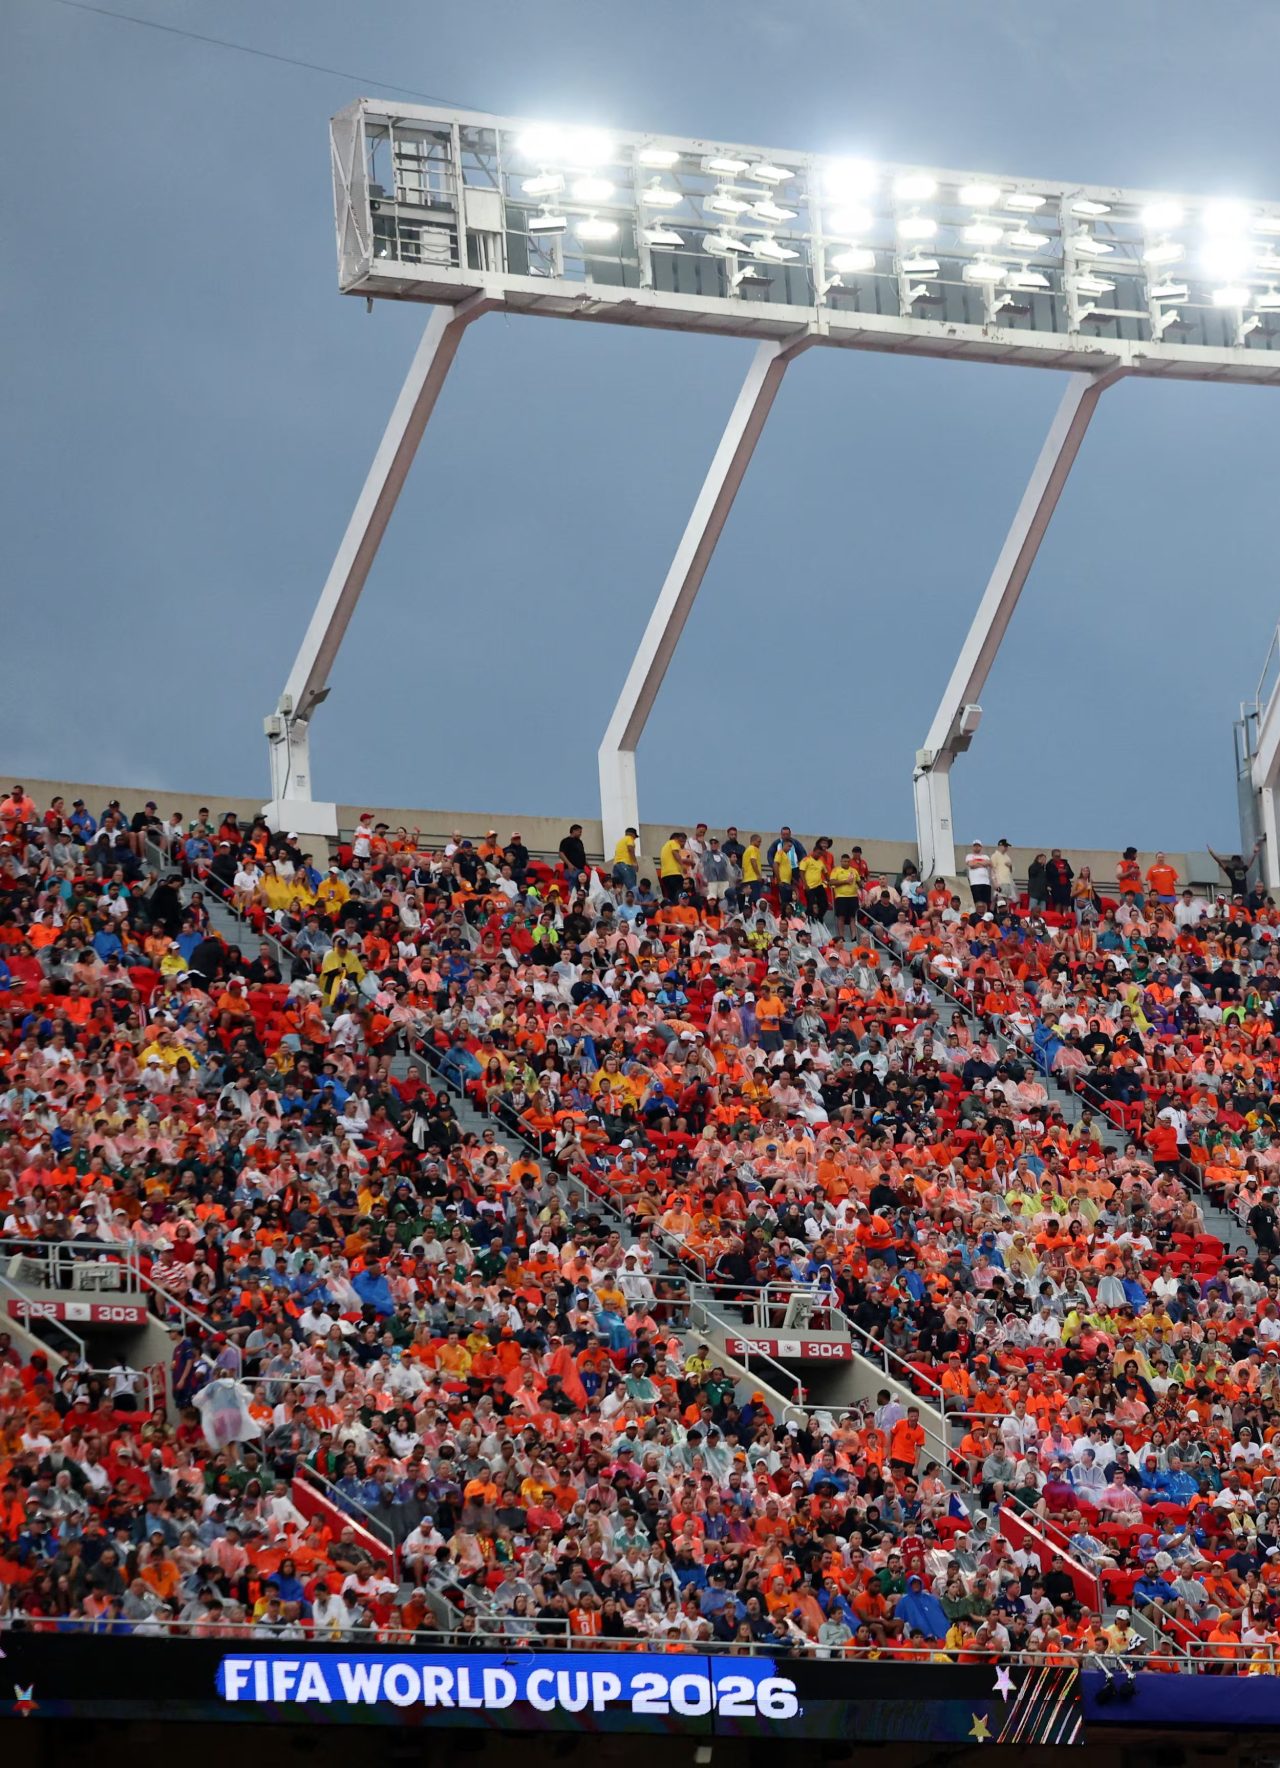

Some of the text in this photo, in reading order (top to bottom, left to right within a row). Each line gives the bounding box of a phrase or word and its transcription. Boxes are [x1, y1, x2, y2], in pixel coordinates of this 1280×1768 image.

[98, 1306, 138, 1322] 303
[734, 1340, 844, 1357] 303 304
[224, 1659, 798, 1719] FIFA WORLD CUP 2026
